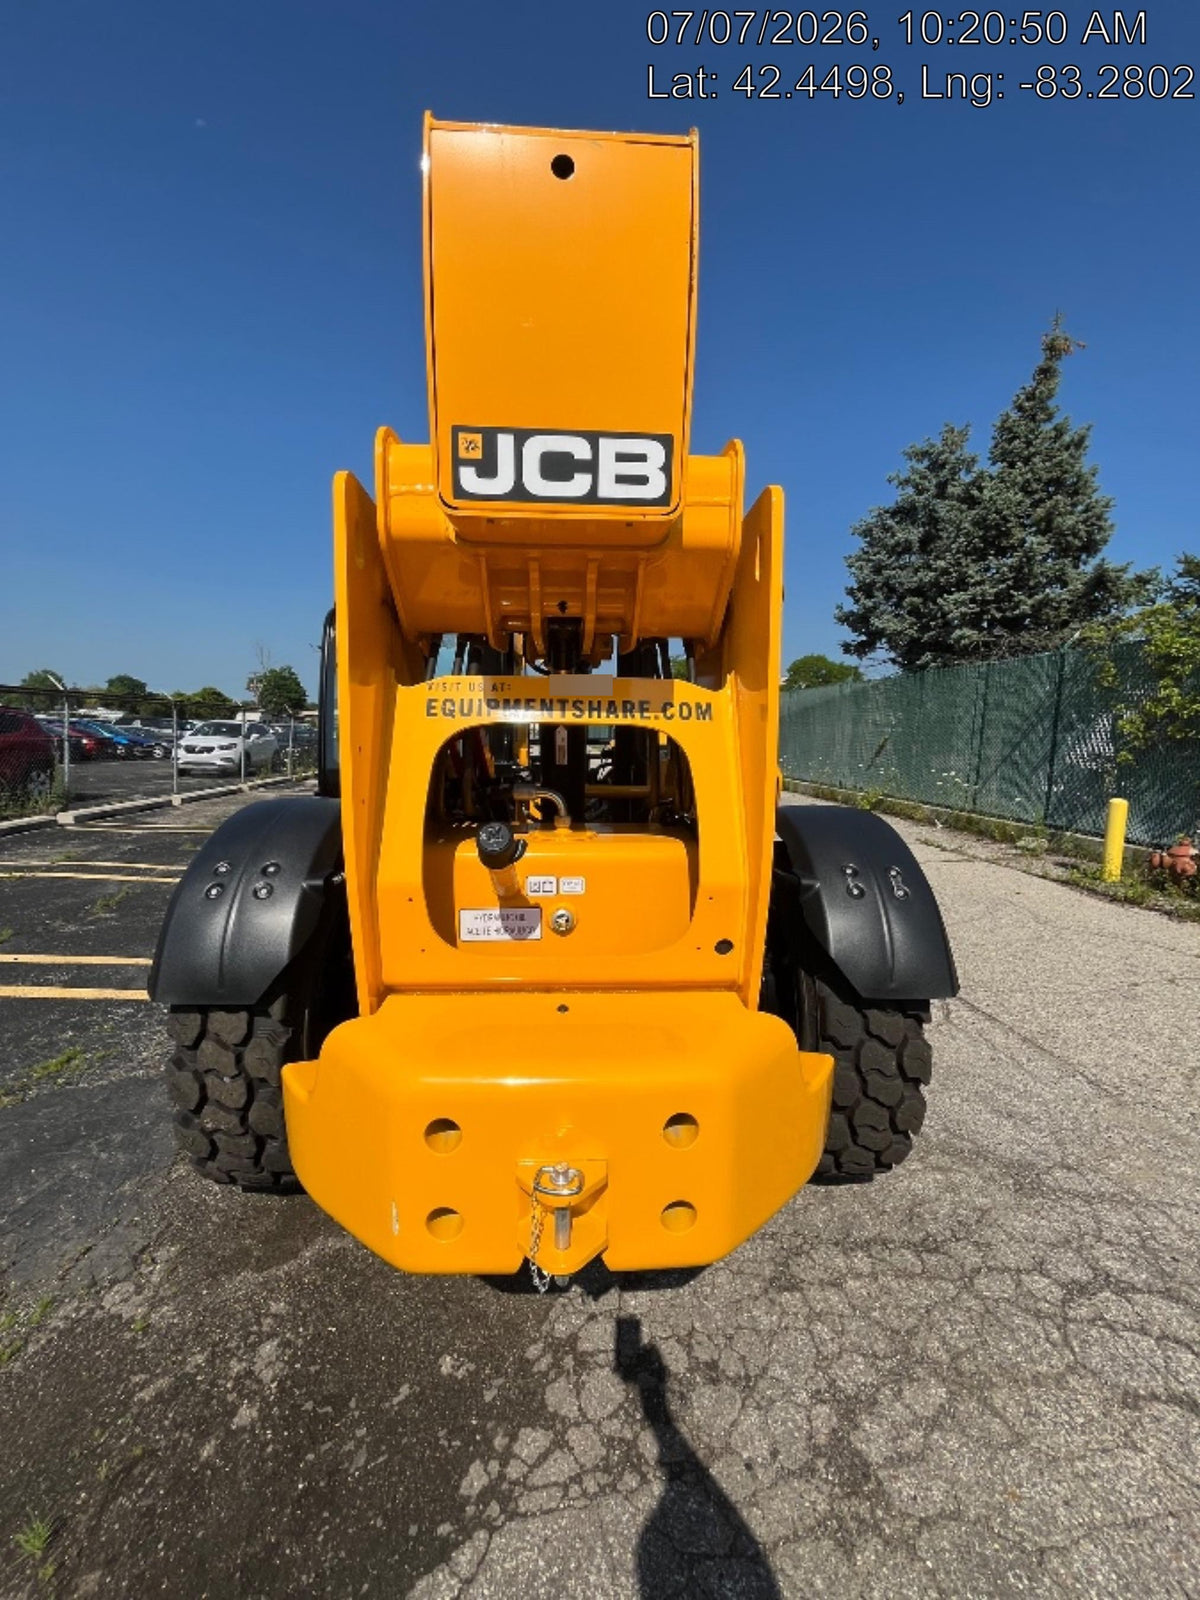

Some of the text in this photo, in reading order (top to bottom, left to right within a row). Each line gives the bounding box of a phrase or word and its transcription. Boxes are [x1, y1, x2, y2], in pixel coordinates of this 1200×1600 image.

[458, 432, 667, 500] JCB
[490, 682, 512, 693] AT:
[426, 697, 713, 721] EQUIPMENTSHARE.COM
